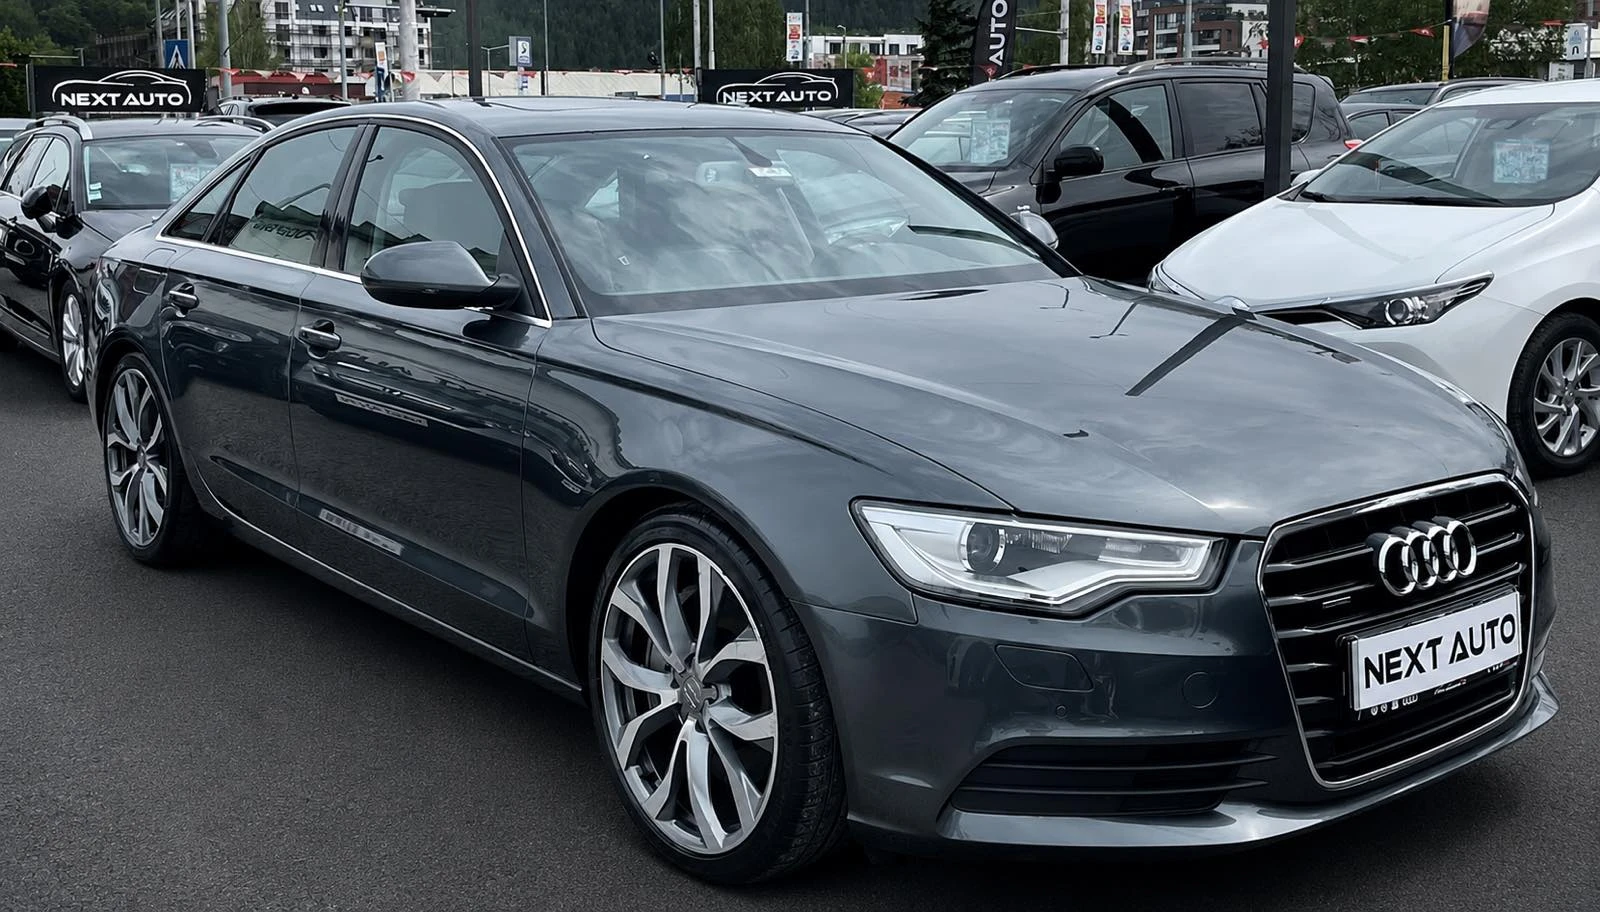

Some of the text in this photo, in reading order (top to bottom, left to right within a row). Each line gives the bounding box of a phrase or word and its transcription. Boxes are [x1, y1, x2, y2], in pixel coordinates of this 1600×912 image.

[989, 0, 1008, 67] AUTO
[61, 93, 184, 106] NEXT AUTO
[723, 90, 832, 104] NEXT AUTO
[1364, 613, 1515, 689] NEXT AUTO
